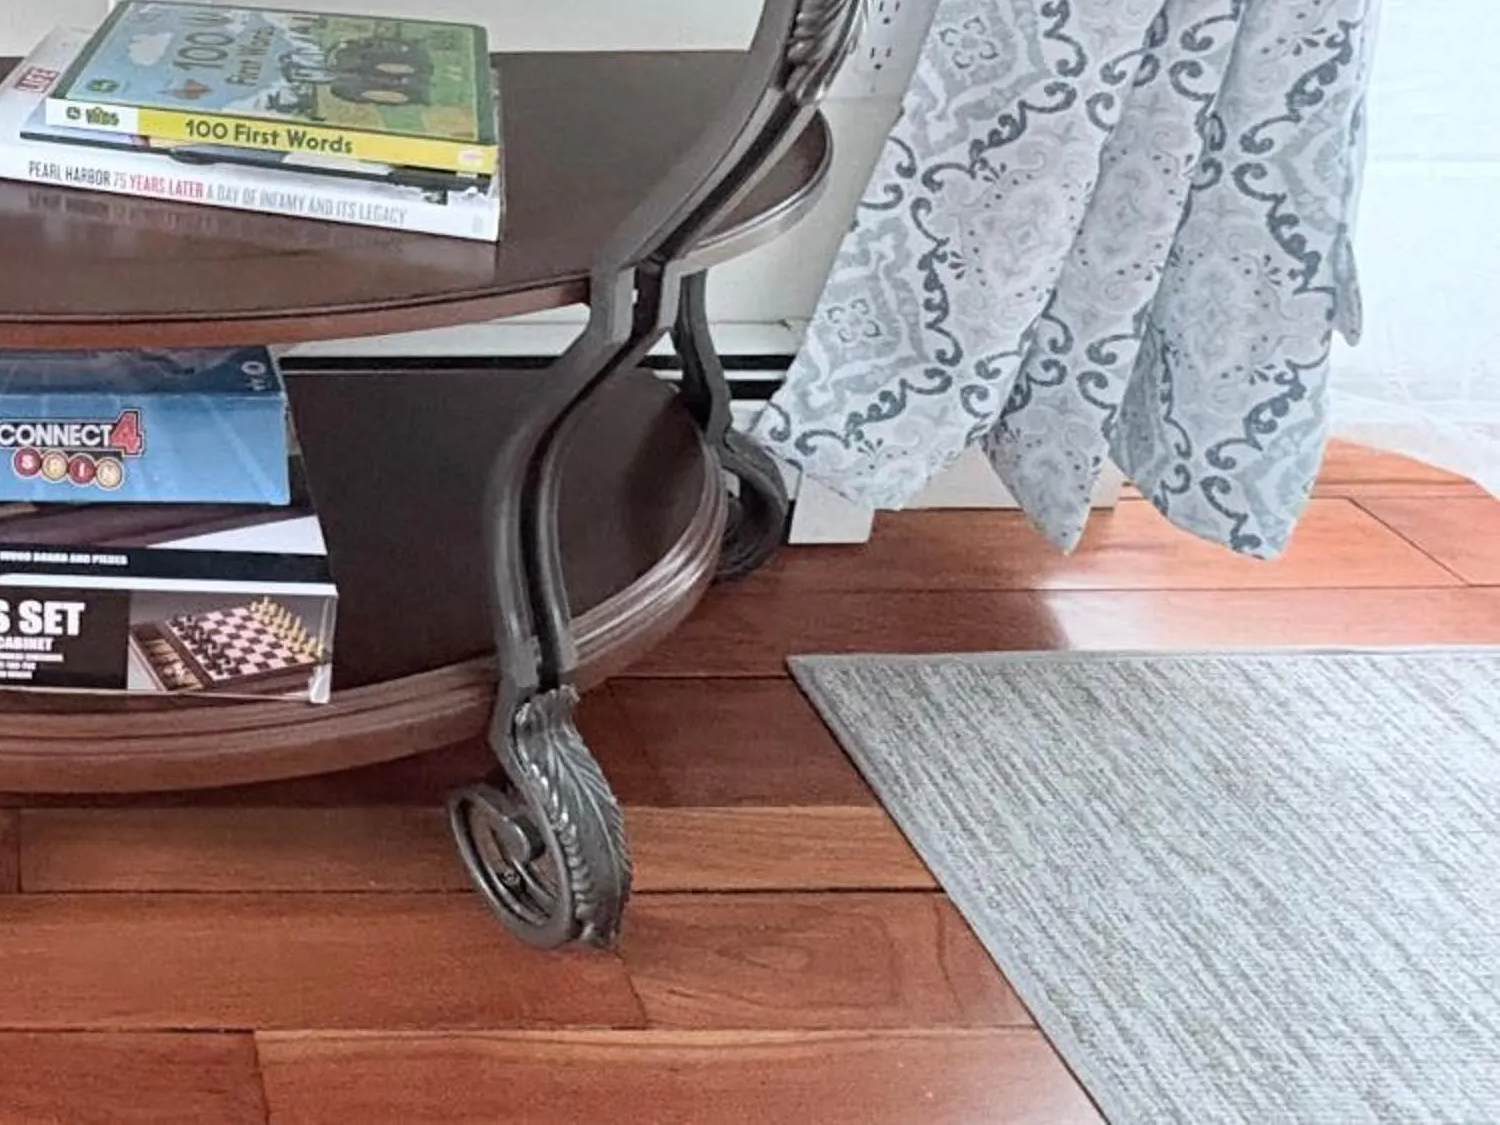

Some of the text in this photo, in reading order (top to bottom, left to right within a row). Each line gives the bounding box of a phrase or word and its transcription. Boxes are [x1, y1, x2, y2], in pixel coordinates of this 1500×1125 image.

[185, 119, 353, 154] 100 First Words
[28, 160, 408, 226] PEARL HARBOR 75 YEARS LATER A DAY OF INFAMY AND ITS LEGACY
[110, 411, 143, 454] 4
[17, 599, 86, 636] SET
